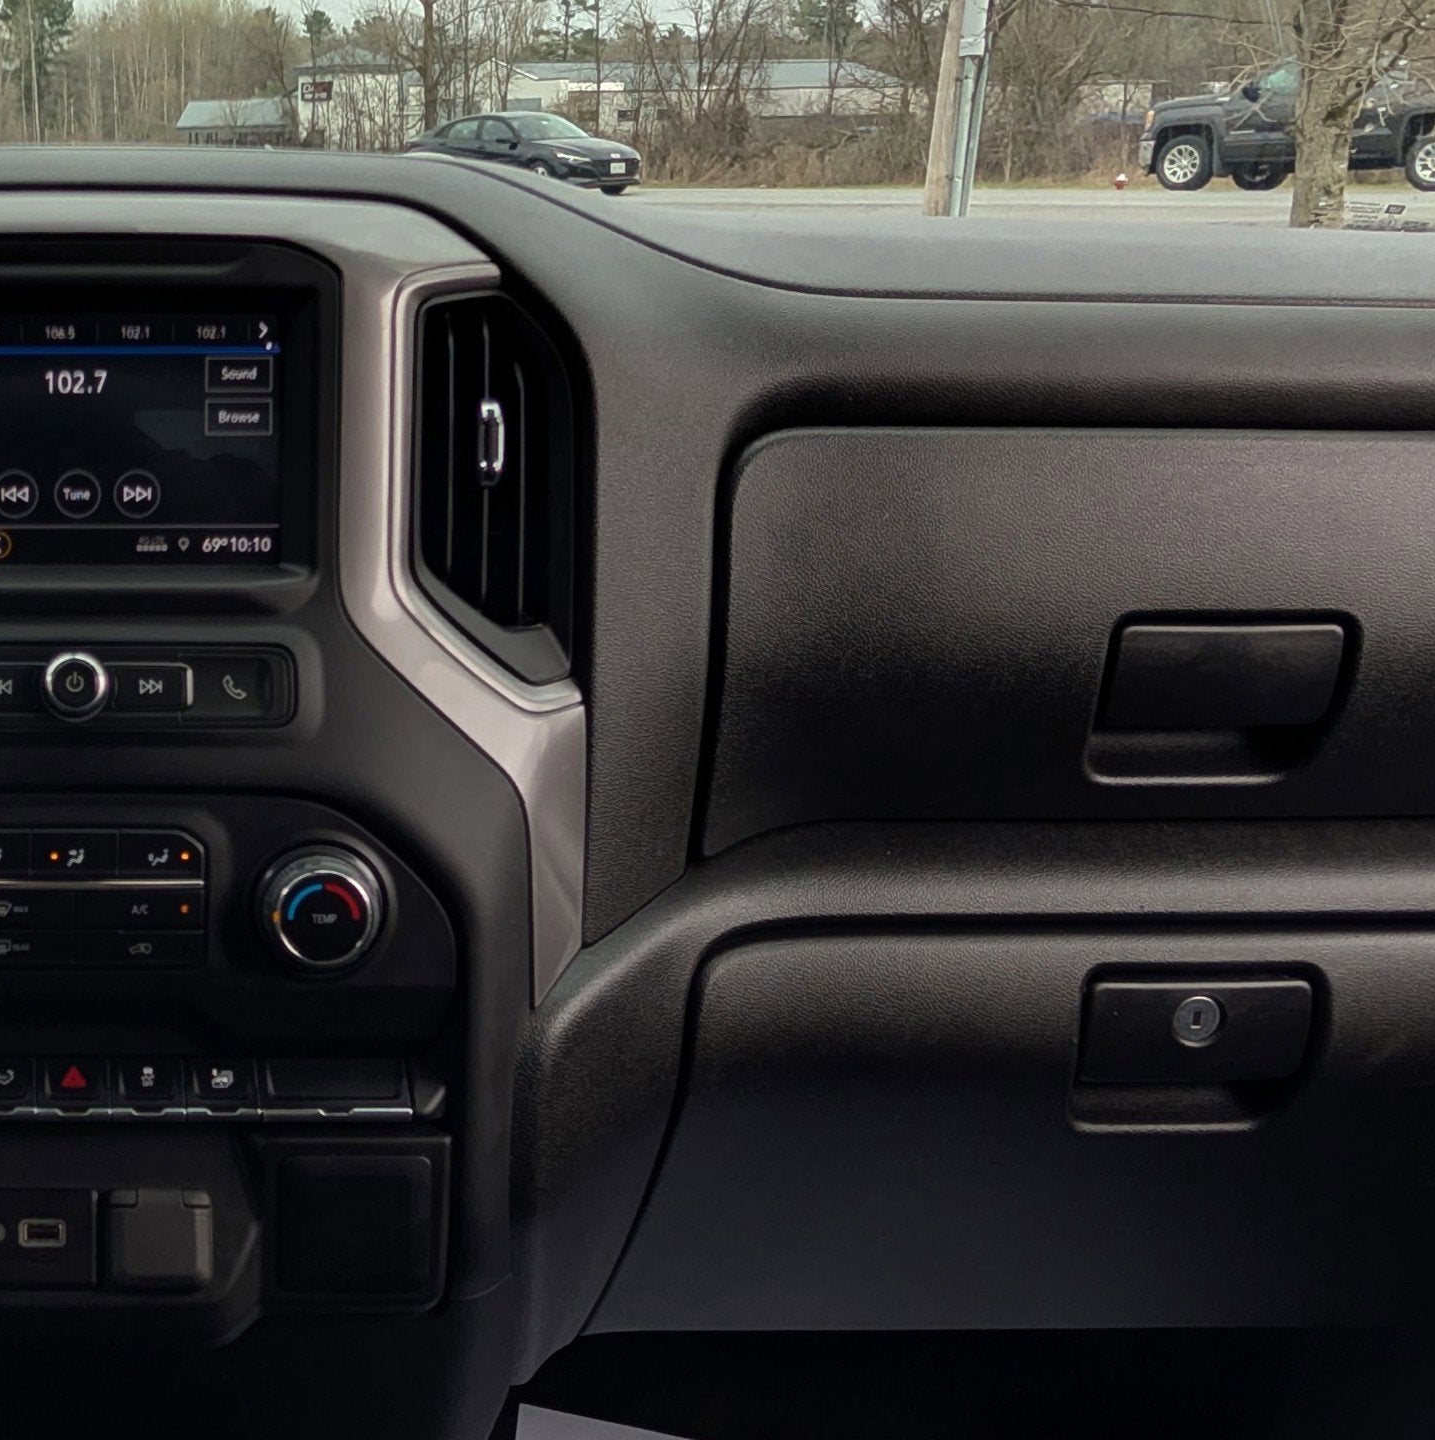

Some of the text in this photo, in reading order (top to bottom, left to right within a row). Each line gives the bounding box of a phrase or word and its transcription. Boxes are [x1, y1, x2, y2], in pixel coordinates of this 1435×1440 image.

[220, 366, 258, 381] Sound
[44, 369, 108, 395] 102.7
[218, 410, 261, 424] Browse
[62, 487, 91, 501] Tune
[230, 537, 272, 553] 10:10
[131, 905, 150, 916] A/C
[311, 913, 338, 925] TEMP
